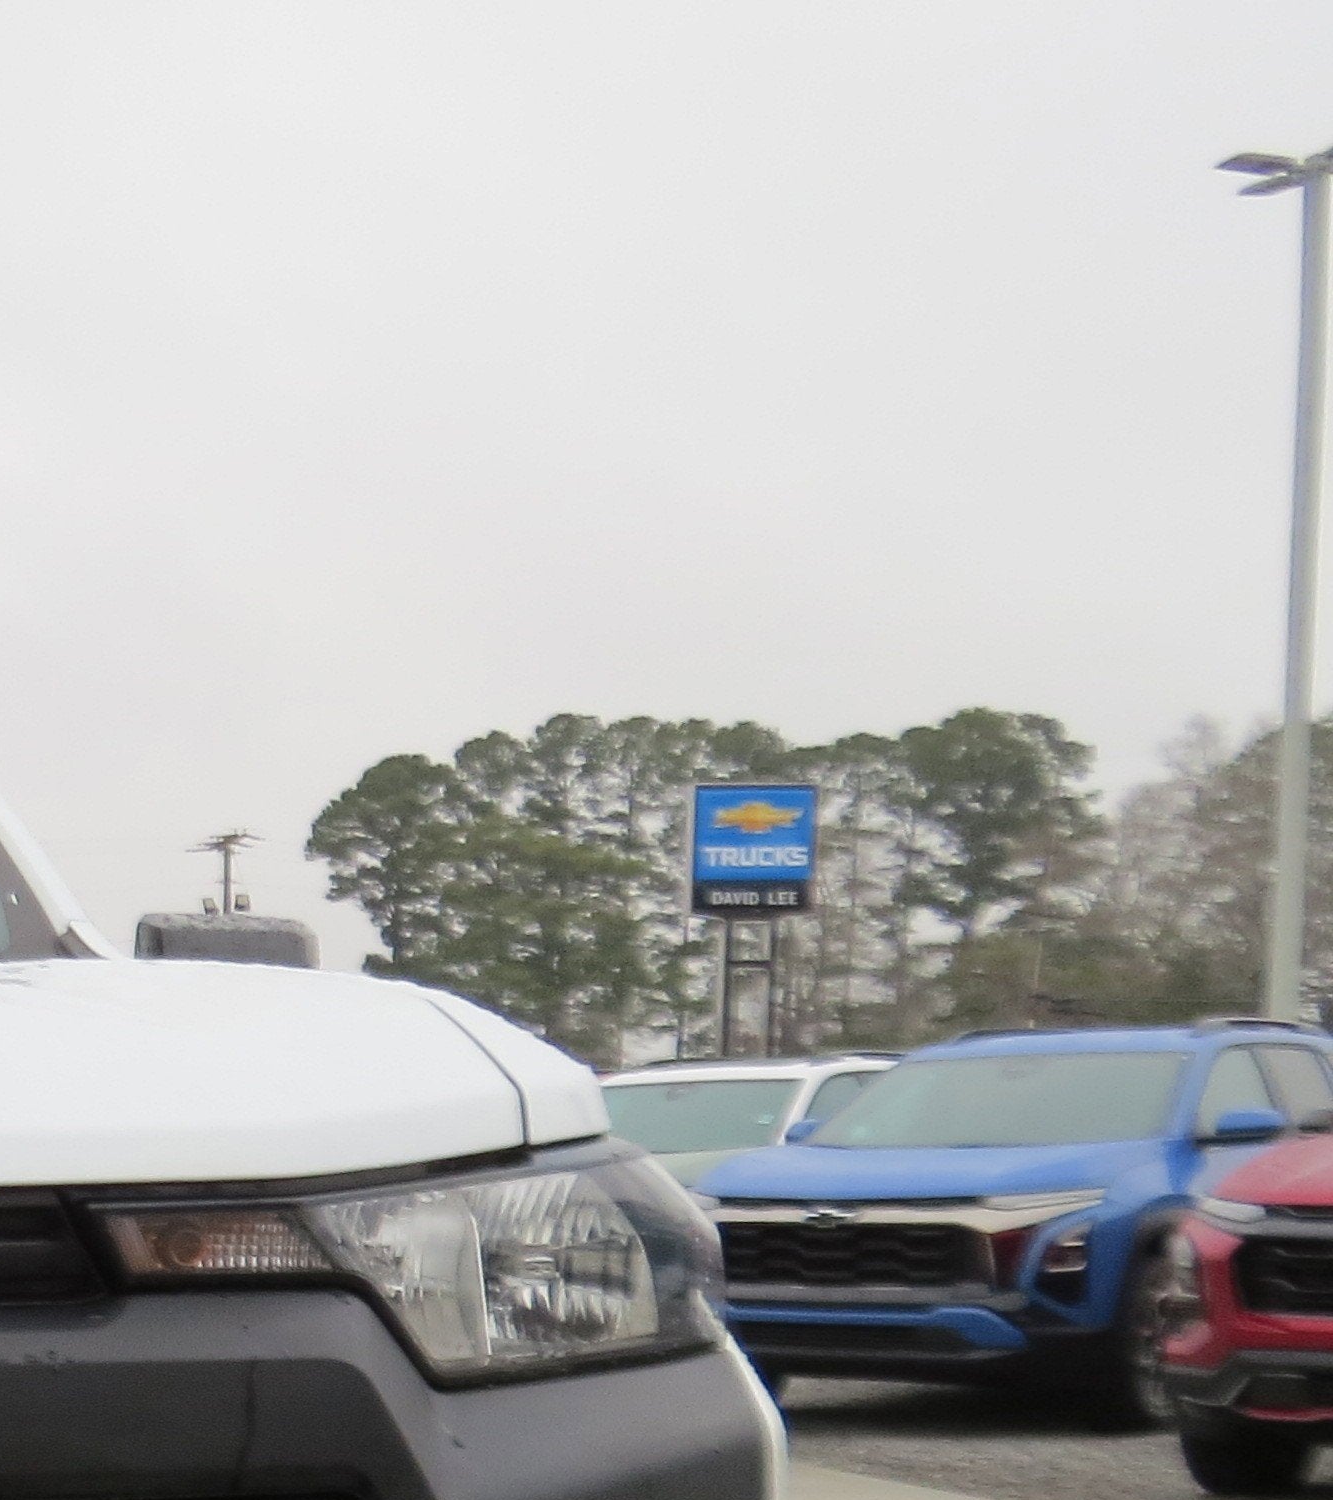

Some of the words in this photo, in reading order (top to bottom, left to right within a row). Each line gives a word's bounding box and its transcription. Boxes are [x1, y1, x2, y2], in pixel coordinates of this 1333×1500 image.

[702, 846, 809, 867] TRUCKS
[711, 891, 760, 906] DAVID
[768, 891, 799, 906] LEE
